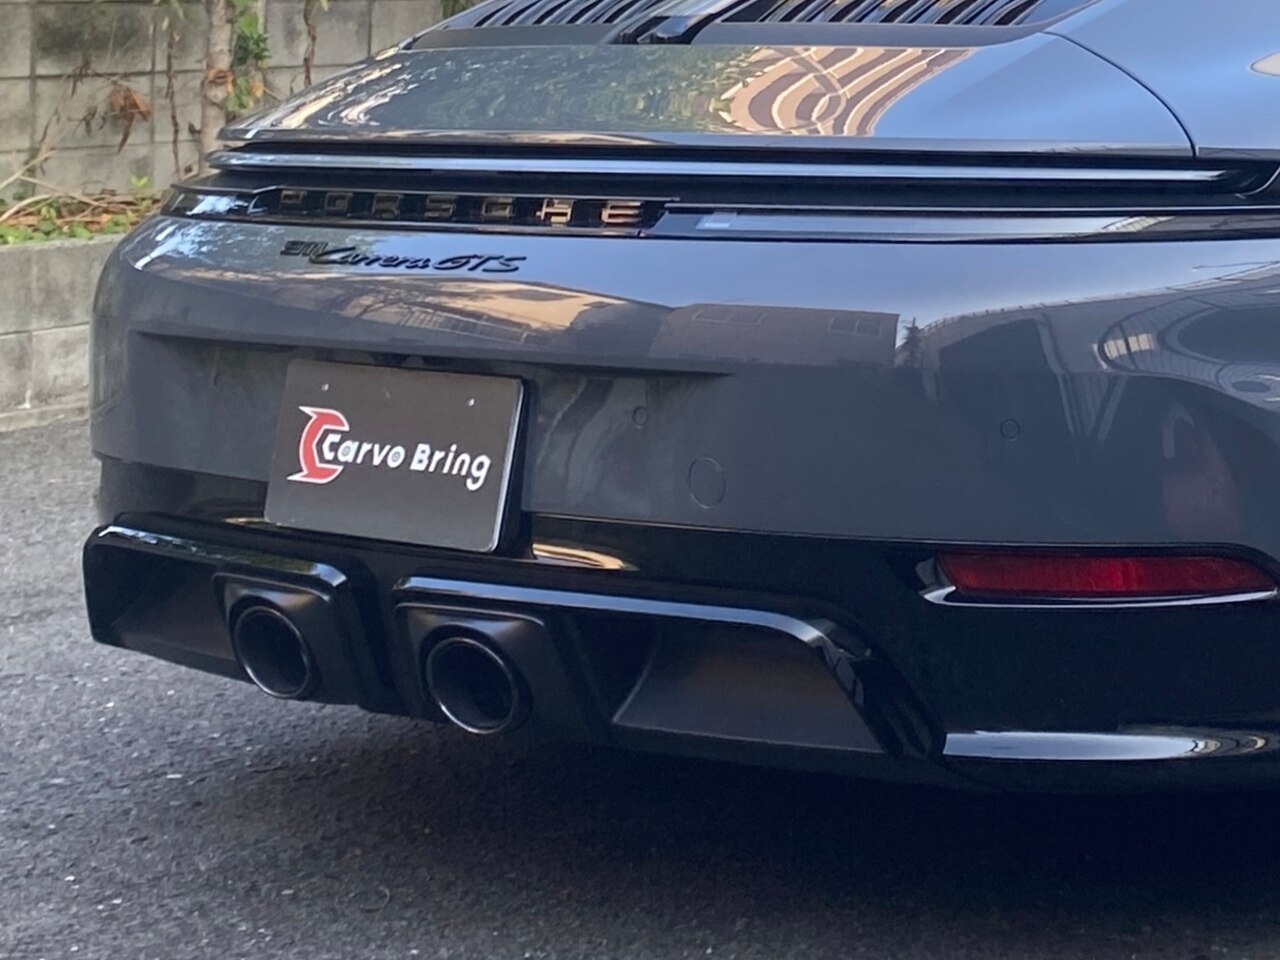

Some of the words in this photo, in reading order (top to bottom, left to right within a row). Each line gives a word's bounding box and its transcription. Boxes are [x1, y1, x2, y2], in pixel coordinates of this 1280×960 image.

[278, 189, 643, 227] PORSCHE
[308, 246, 431, 270] Carrera
[433, 254, 527, 273] GTS
[322, 433, 405, 468] Carvo
[410, 444, 491, 491] Bring
